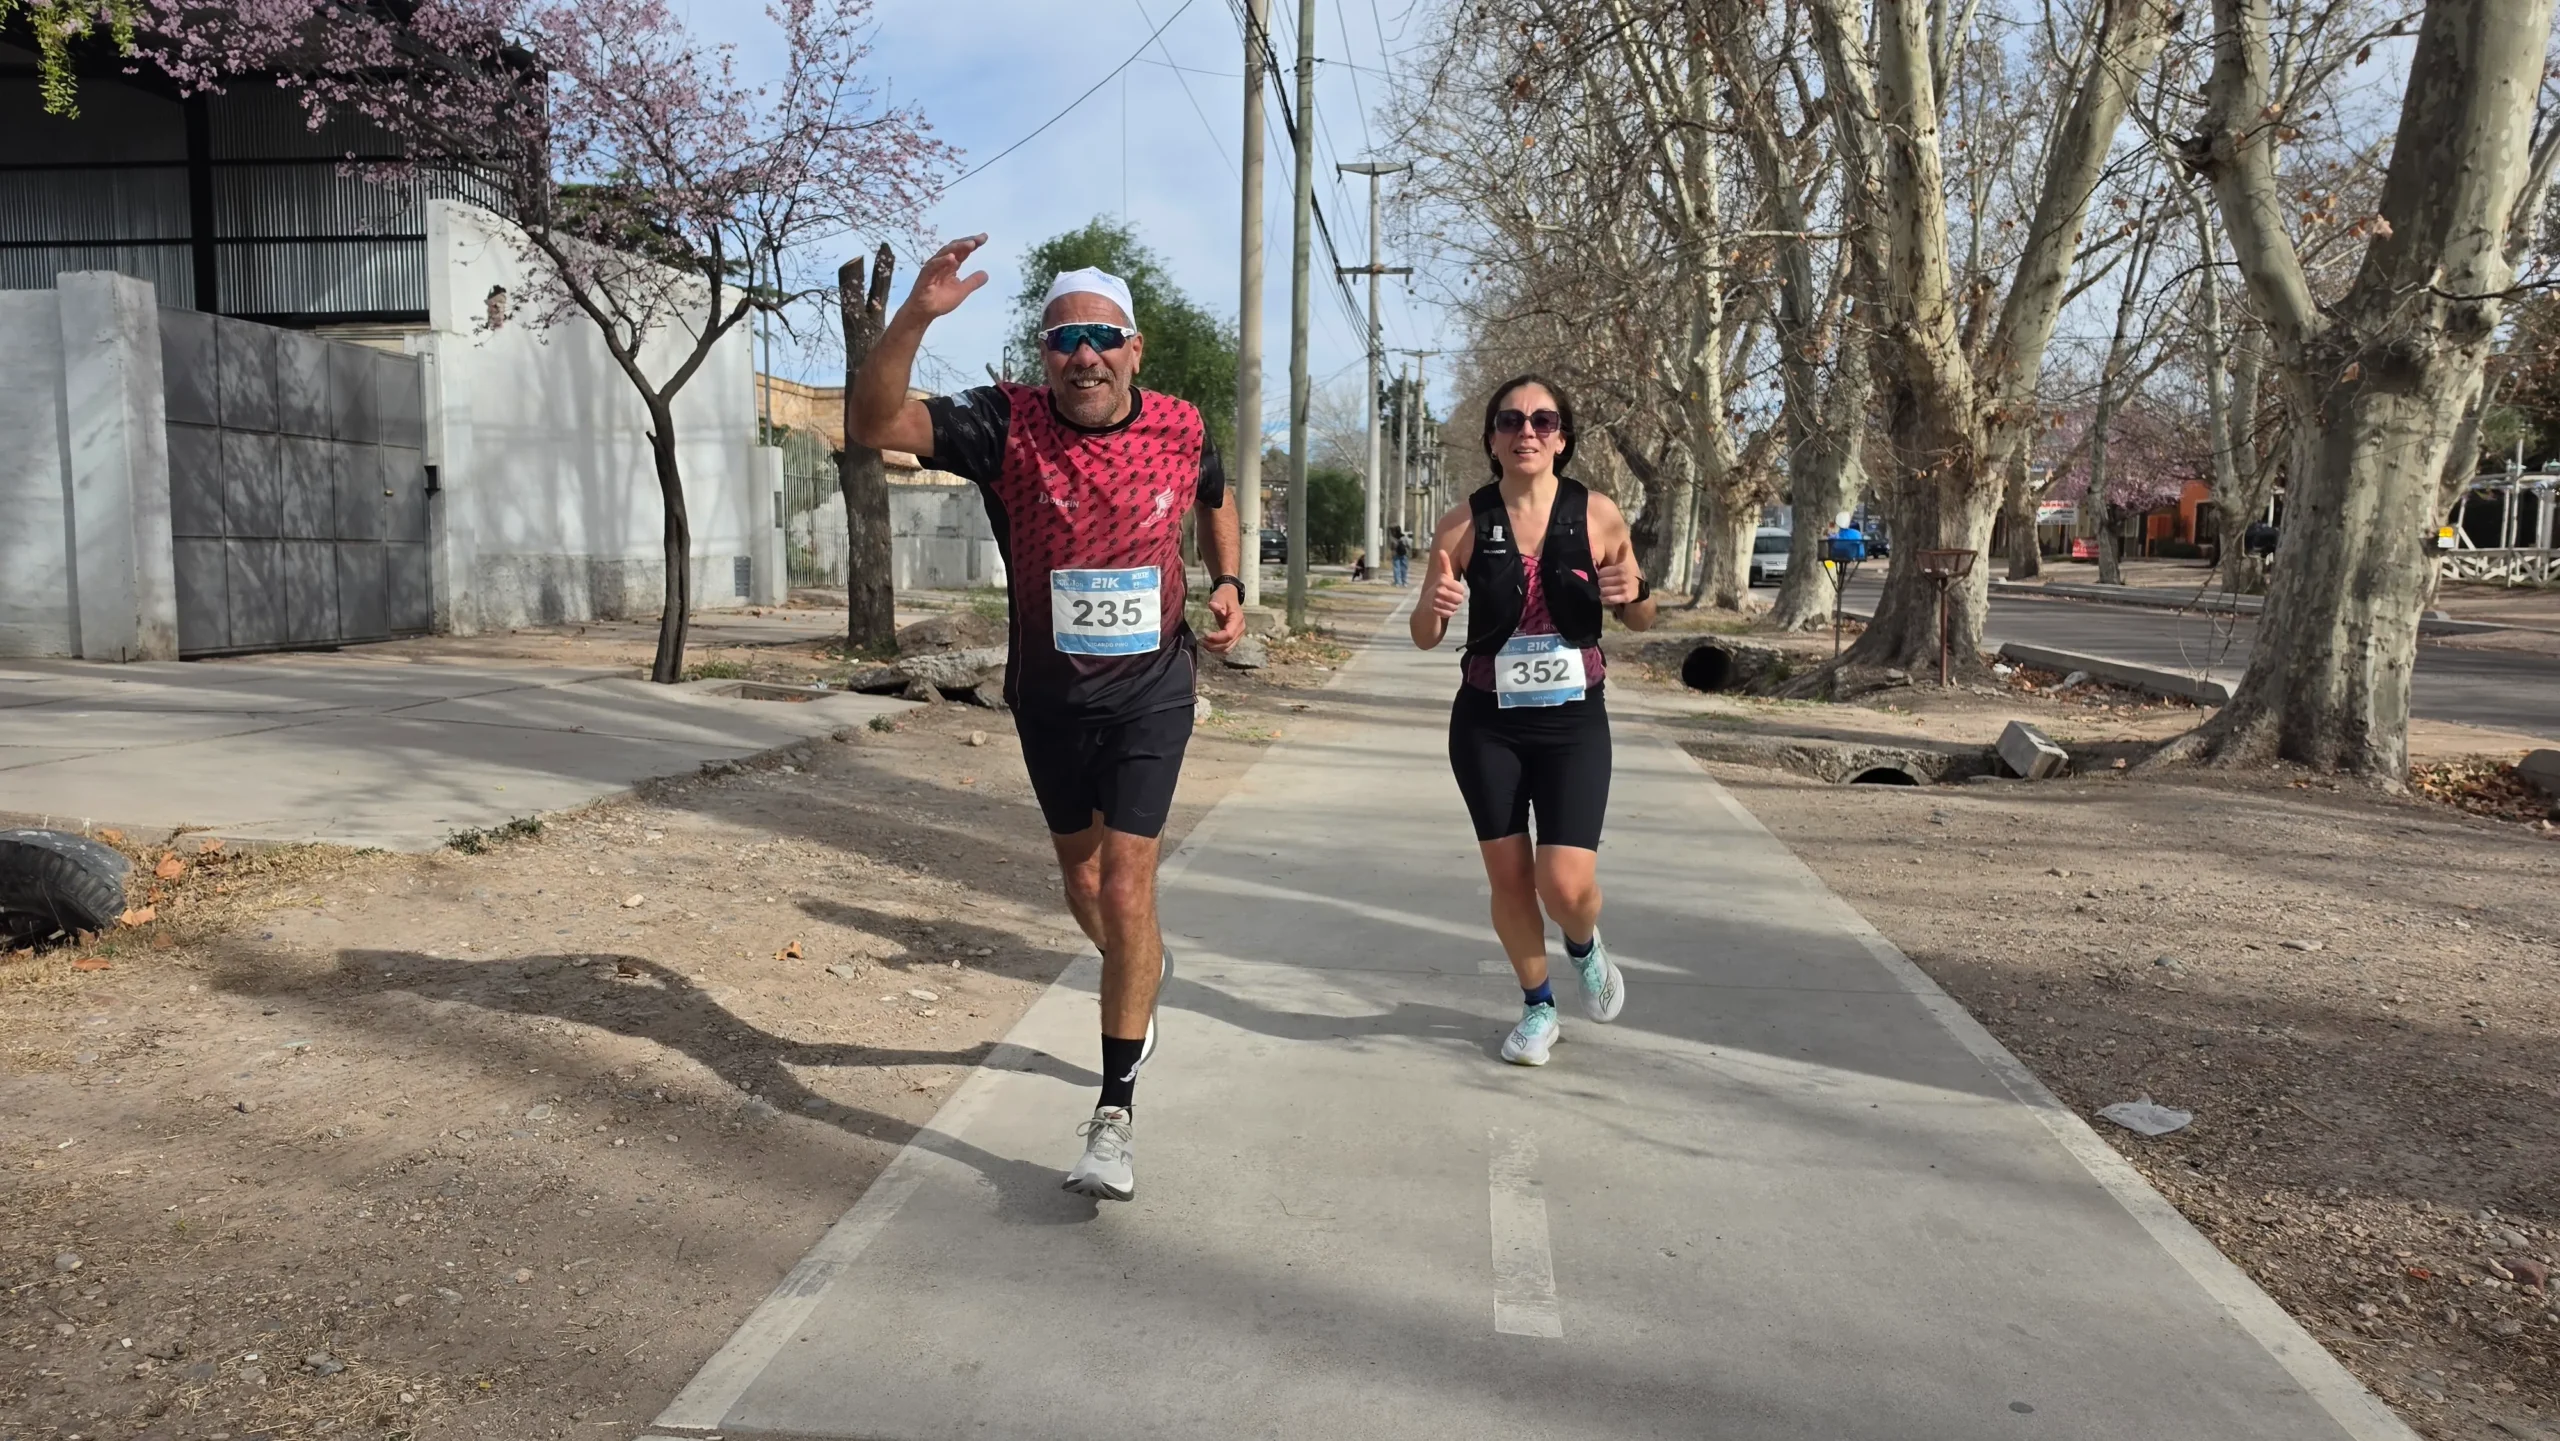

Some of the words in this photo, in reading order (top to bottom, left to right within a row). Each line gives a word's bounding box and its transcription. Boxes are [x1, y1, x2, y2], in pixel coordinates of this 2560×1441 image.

[1091, 577, 1120, 589] 21K
[1072, 598, 1142, 627] 235
[1527, 640, 1551, 652] 21K
[1512, 658, 1570, 685] 352
